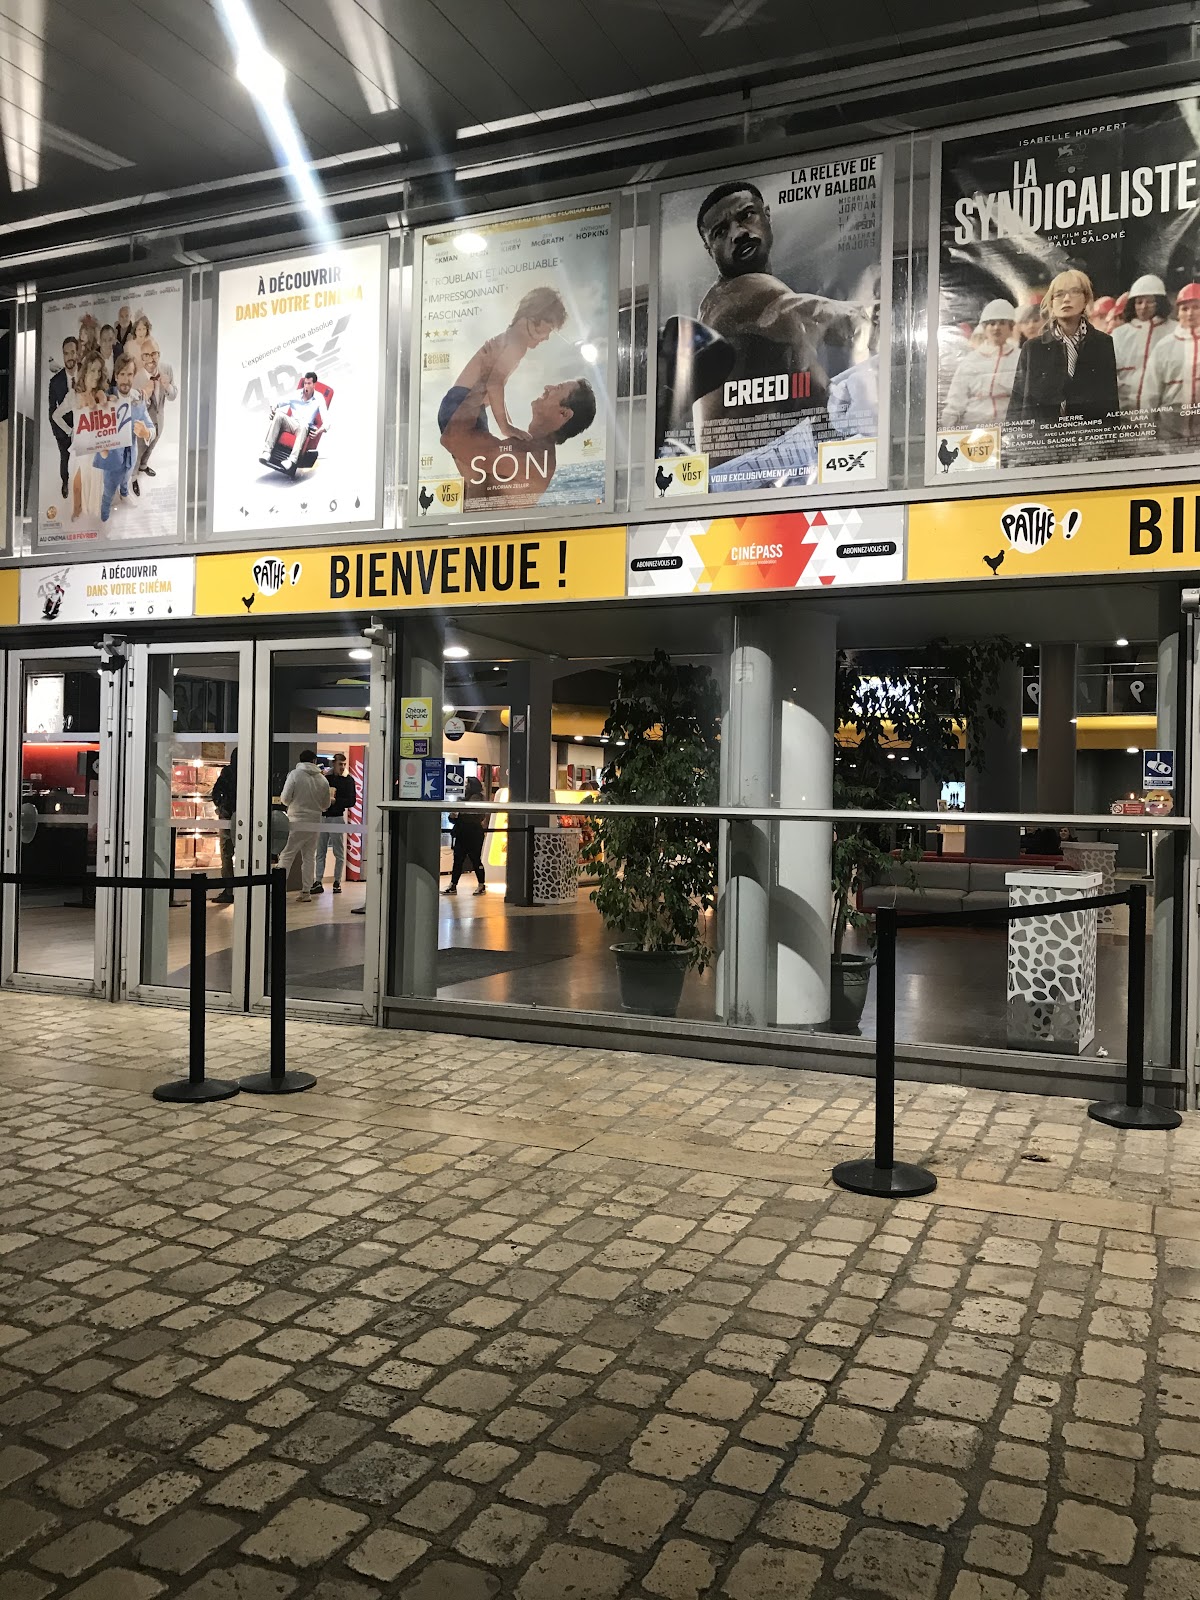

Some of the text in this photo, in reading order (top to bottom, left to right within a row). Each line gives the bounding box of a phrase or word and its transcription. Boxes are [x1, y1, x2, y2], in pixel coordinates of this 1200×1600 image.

[1019, 122, 1127, 147] ISABELLE HUPPERT
[791, 169, 807, 185] LA
[860, 157, 876, 172] DE
[1013, 158, 1037, 189] LA
[778, 174, 877, 205] ROCKY BALBOA
[838, 201, 876, 214] JORDAN
[954, 160, 1198, 245] SYNDICALISTE
[531, 236, 565, 247] McGRATH
[576, 229, 609, 240] HOPKINS
[1061, 231, 1080, 239] FILM
[1081, 230, 1126, 244] SALOMÉ
[837, 239, 875, 252] MAJORS
[498, 257, 559, 276] INOUBLIABLE
[257, 266, 342, 296] À DÉCOUVRIR
[428, 284, 505, 304] IMPRESSIONNANT
[235, 301, 268, 322] DANS
[271, 294, 310, 316] VOTRE
[428, 306, 480, 320] FASCINANT
[282, 332, 306, 349] cinéma
[307, 319, 334, 337] absolue
[723, 371, 811, 408] CREED III
[76, 402, 132, 435] Alibi 2
[1058, 414, 1084, 422] PIERRE
[1105, 408, 1149, 418] ALEXANDRA
[1130, 414, 1149, 422] LARA
[1039, 419, 1103, 430] DELADONCHAMPS
[1133, 422, 1157, 430] ATTAL
[95, 427, 117, 439] .com
[1084, 433, 1118, 441] FADETTE
[1119, 429, 1157, 438] DROUARD
[498, 445, 513, 453] THE
[967, 445, 990, 457] VFST
[421, 456, 434, 466] tiff
[469, 449, 549, 485] SON
[682, 462, 692, 472] VF
[825, 450, 869, 472] 4DX
[682, 470, 702, 481] VOST
[710, 466, 814, 483] VOIR EXCLUSIVEMENT AU CIN
[442, 484, 451, 493] VF
[441, 492, 459, 502] VOST
[1001, 507, 1055, 546] PATHÉ
[1129, 495, 1200, 556] BI
[731, 542, 783, 561] CINÉPASS
[842, 544, 890, 555] ABONNEZ-VOUS ICI
[329, 540, 567, 599] BIENVENUE !
[636, 559, 670, 568] ABONNEZ-VOUS
[101, 564, 158, 580] À DÉCOUVRIR
[253, 558, 286, 588] PATHÉ
[86, 578, 172, 597] DANS VOTRE CINÉMA
